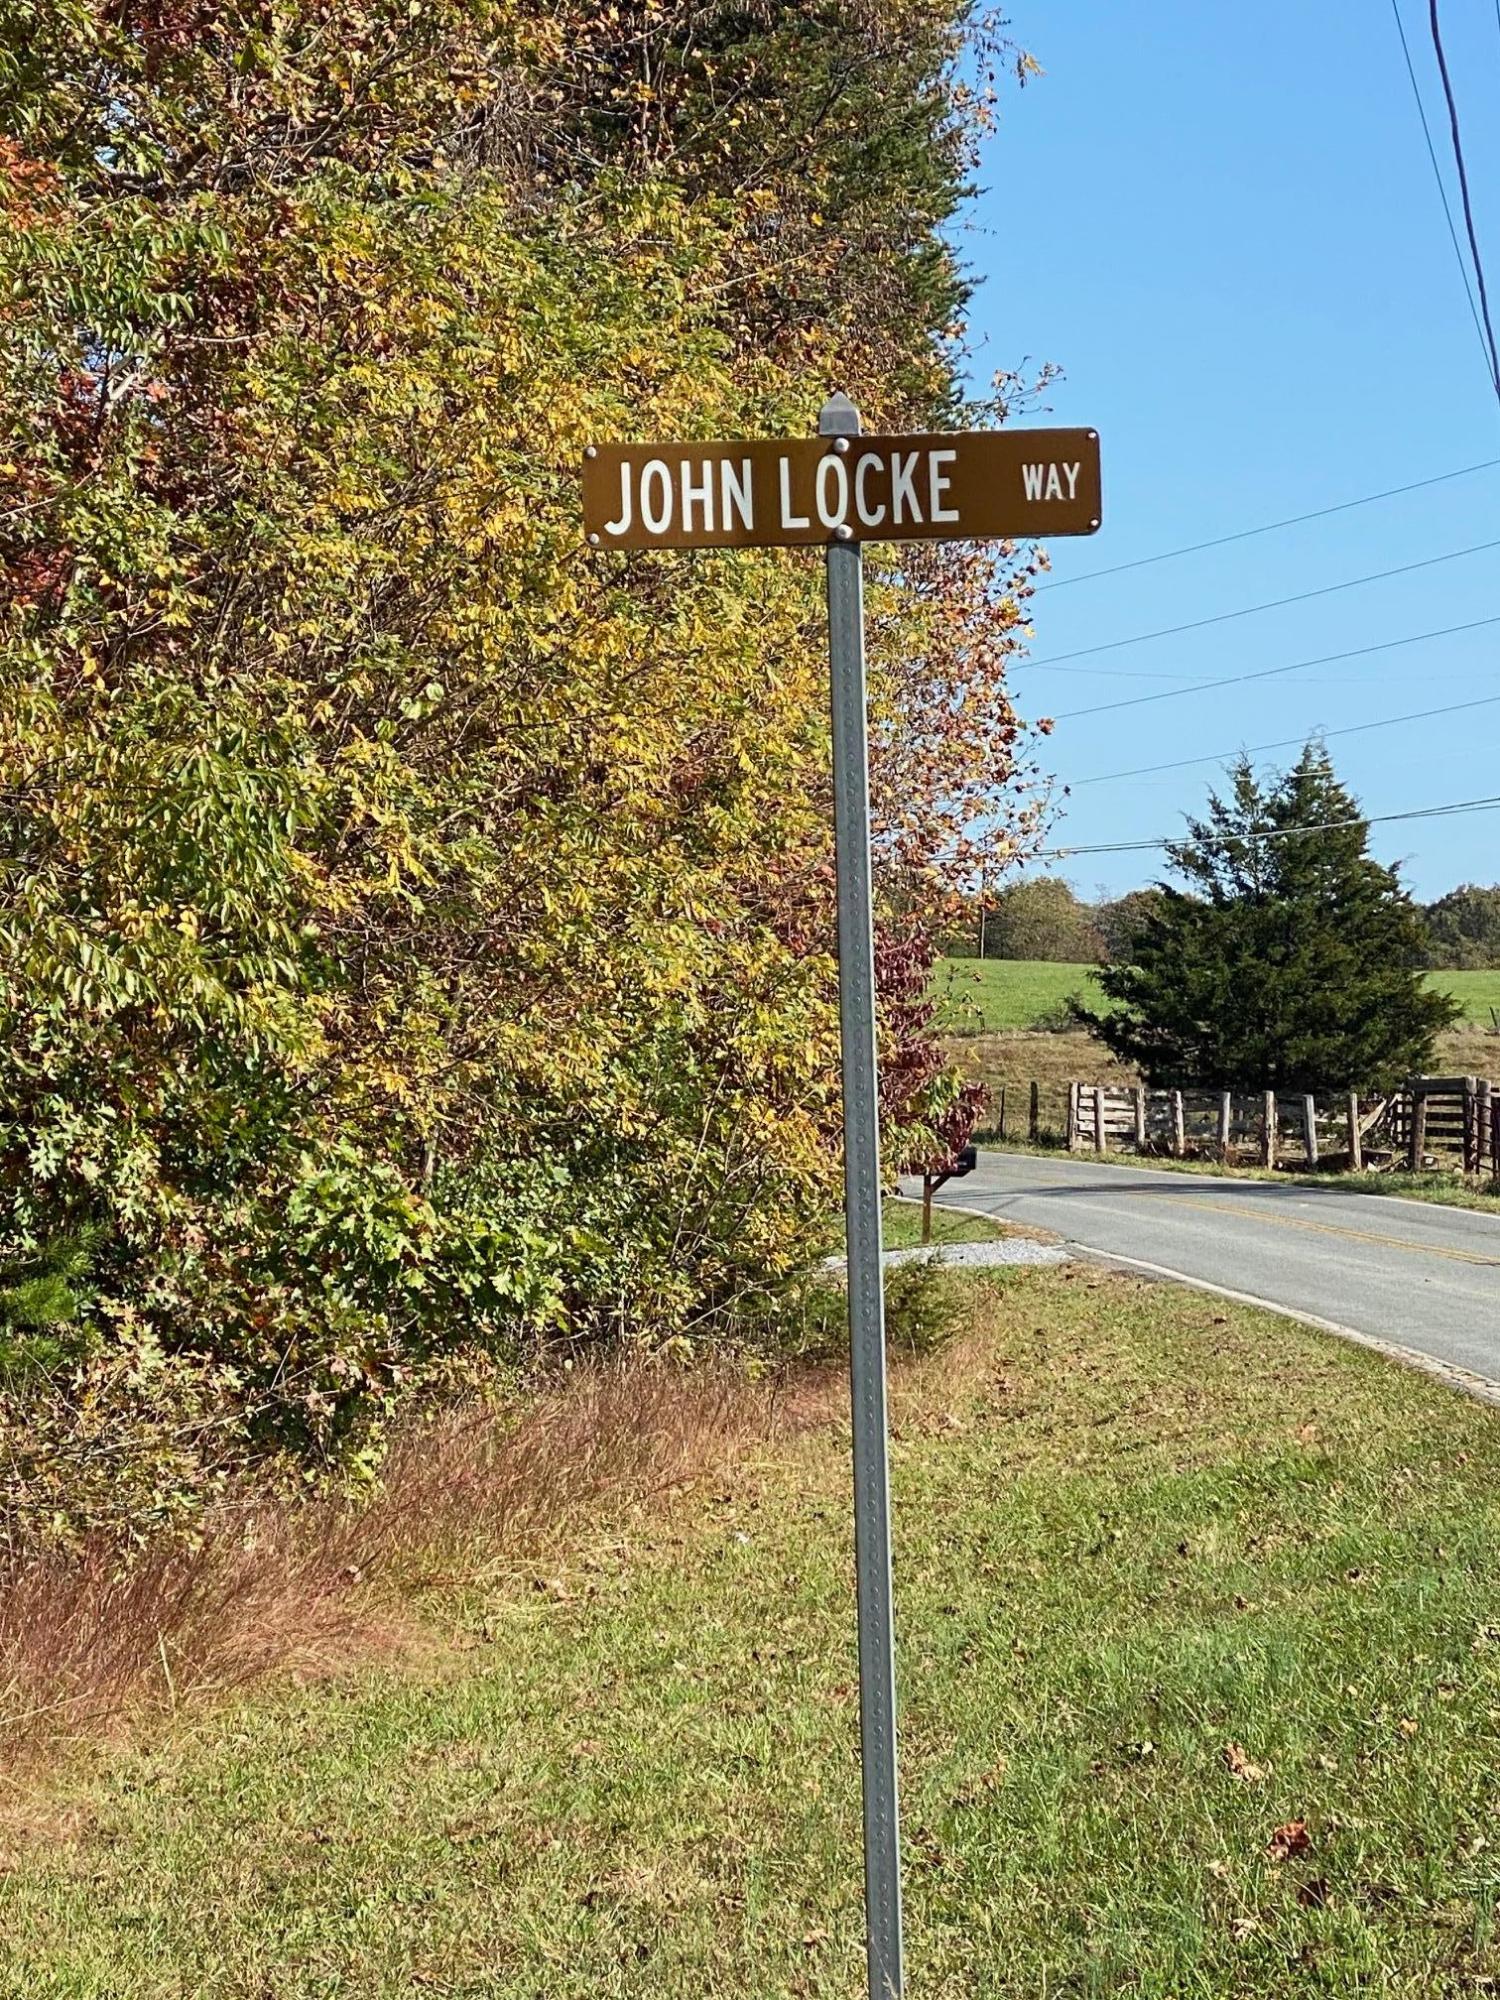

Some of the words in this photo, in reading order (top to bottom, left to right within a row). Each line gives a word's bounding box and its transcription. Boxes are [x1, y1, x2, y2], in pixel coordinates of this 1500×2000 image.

[604, 458, 754, 536] JOHN
[779, 449, 960, 529] LOCKE
[1022, 461, 1080, 501] WAY
